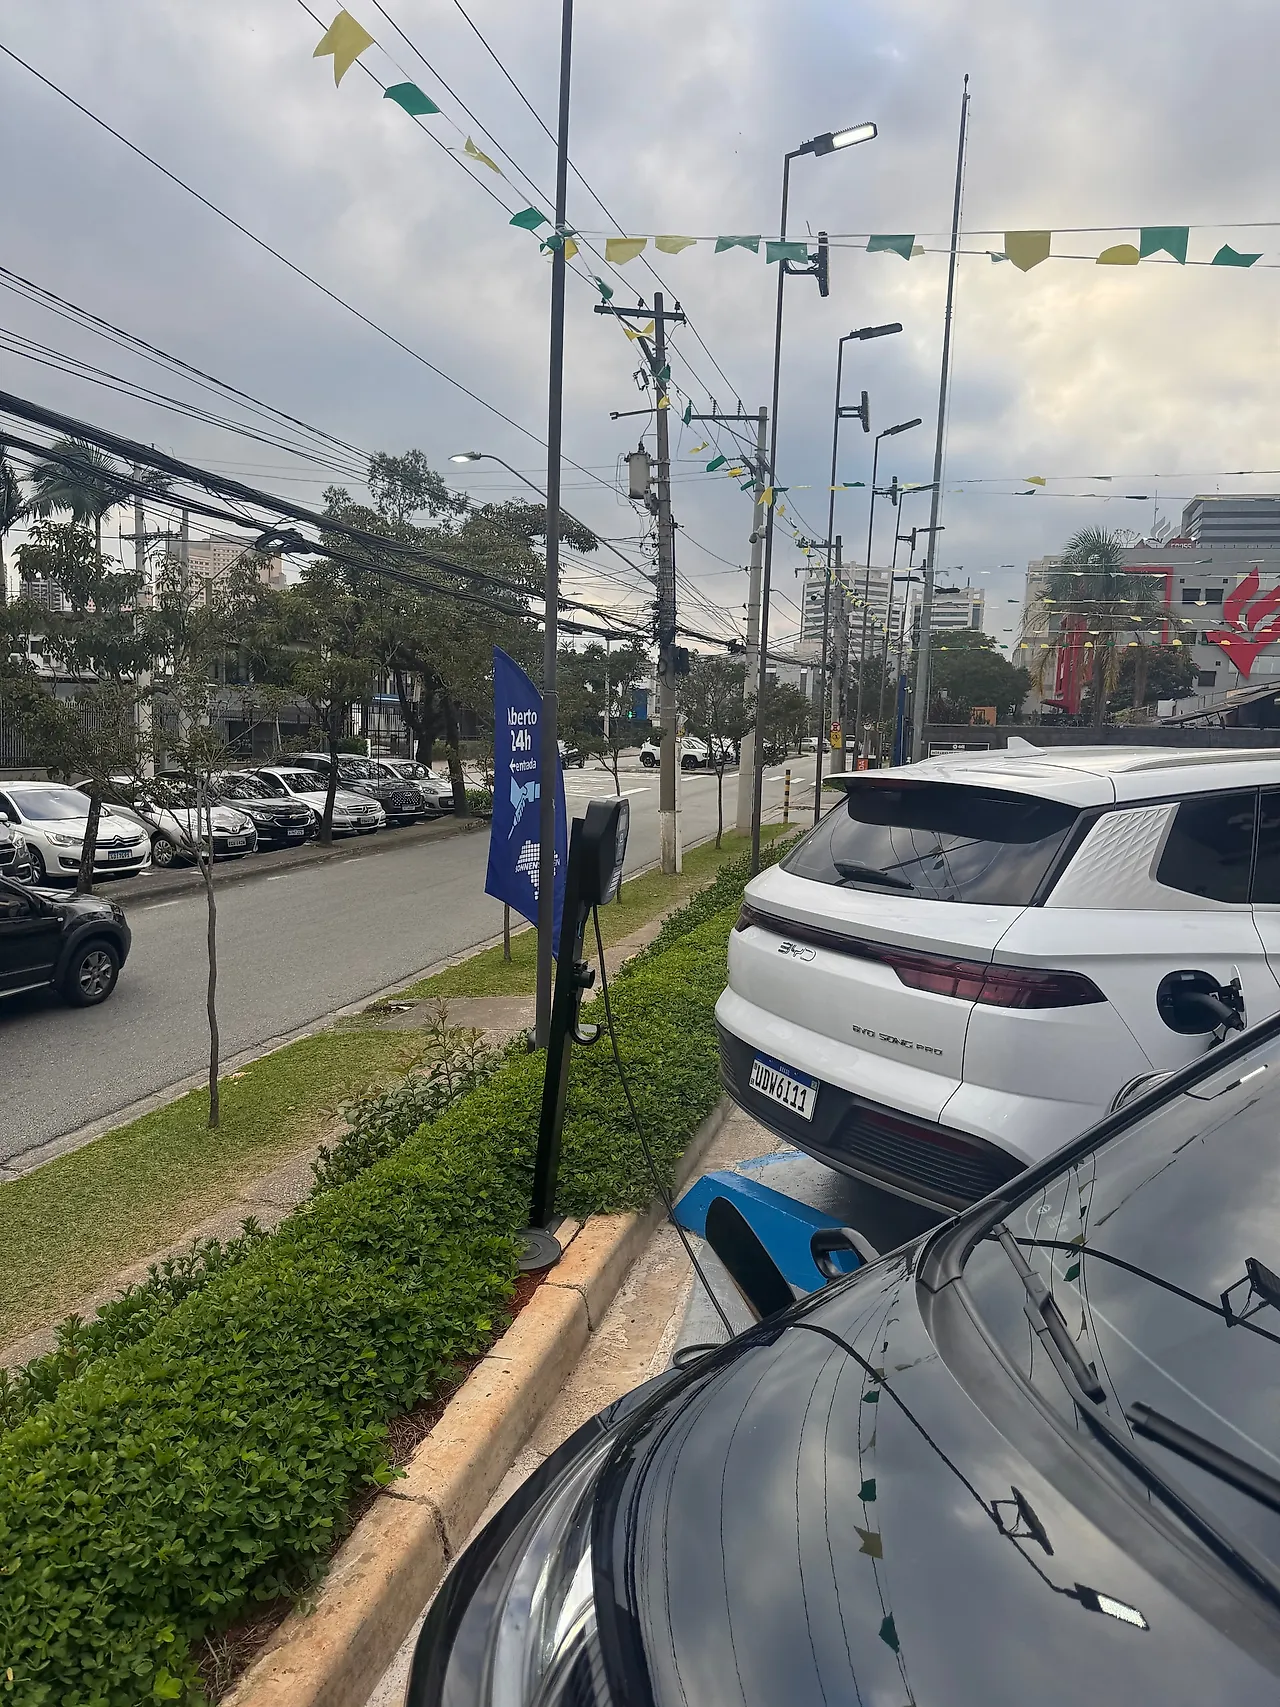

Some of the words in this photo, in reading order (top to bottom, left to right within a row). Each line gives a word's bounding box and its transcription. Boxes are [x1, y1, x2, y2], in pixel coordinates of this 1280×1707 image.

[510, 729, 531, 751] 24h
[879, 1033, 913, 1048] SONG
[916, 1044, 943, 1056] PRO
